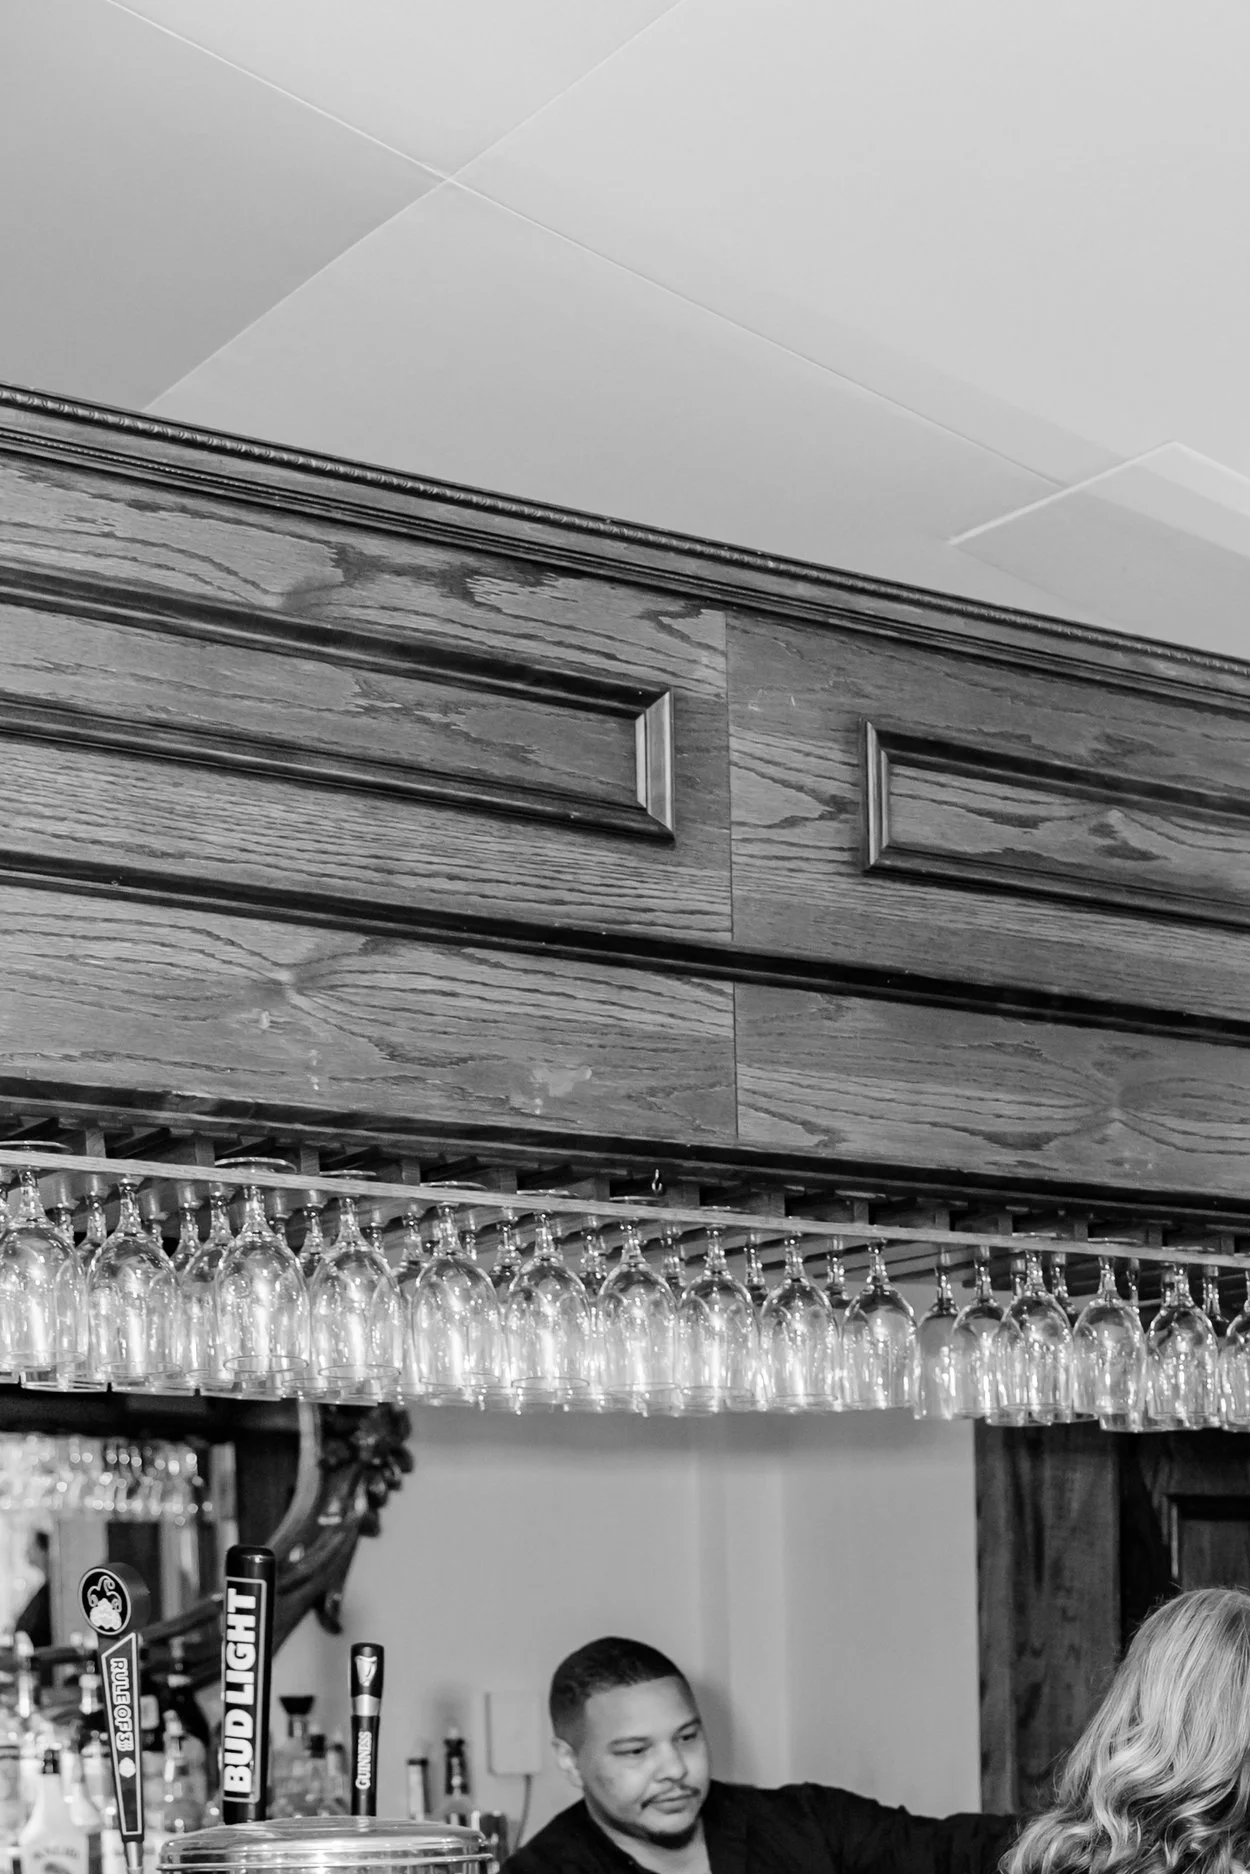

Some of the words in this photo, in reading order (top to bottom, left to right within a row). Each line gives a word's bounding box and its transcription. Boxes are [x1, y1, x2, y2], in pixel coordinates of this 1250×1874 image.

[225, 1588, 257, 1705] LIGHT
[224, 1709, 254, 1793] BUD
[355, 1731, 372, 1790] GUINNESS
